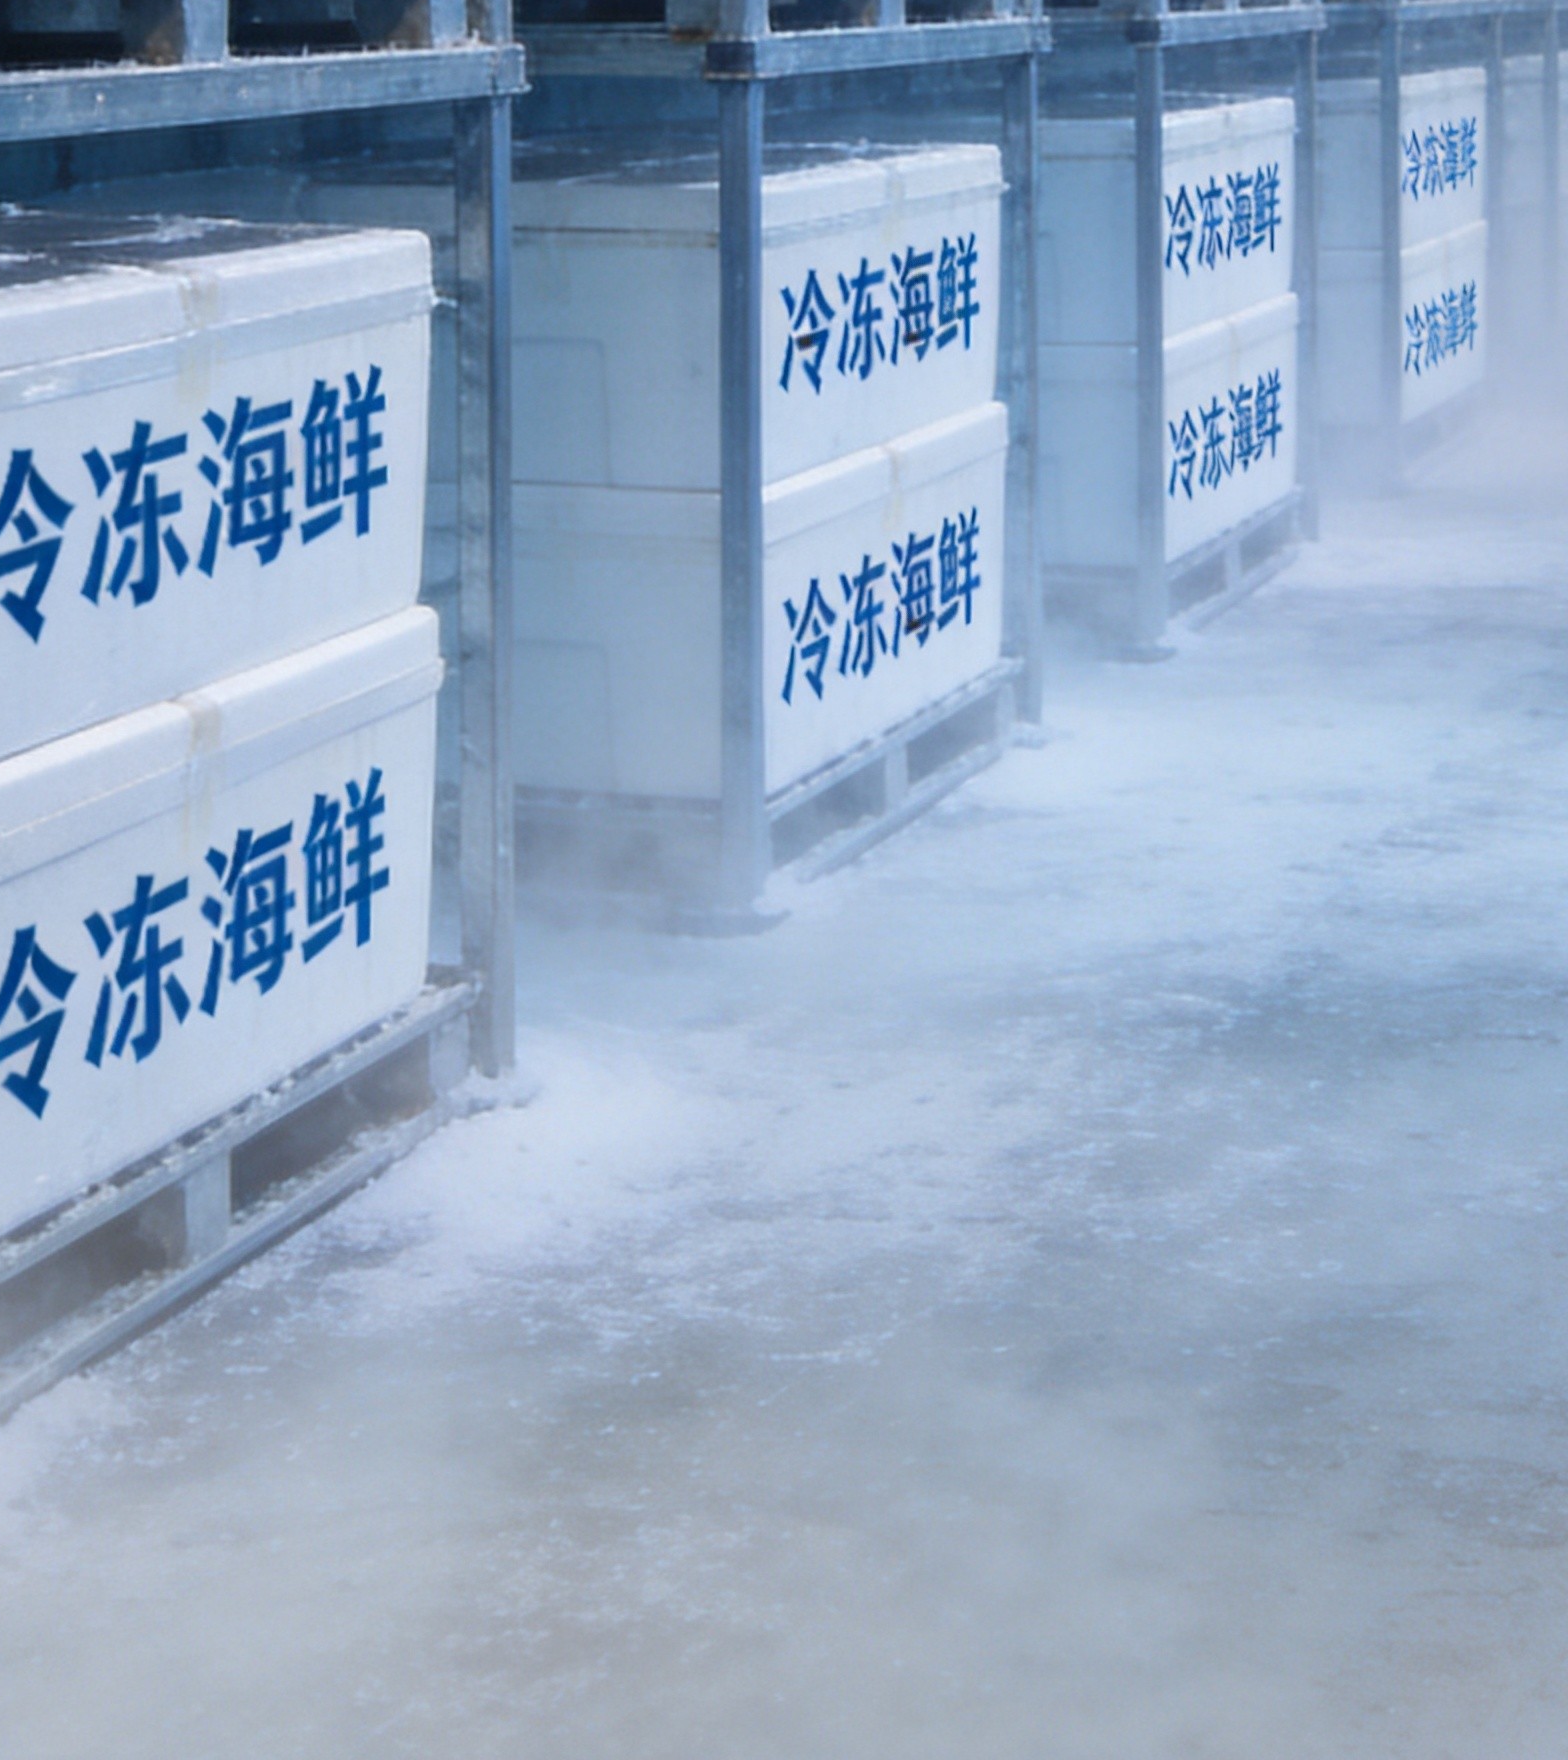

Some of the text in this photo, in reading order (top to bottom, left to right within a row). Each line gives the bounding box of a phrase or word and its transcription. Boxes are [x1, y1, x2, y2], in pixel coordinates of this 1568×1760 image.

[1165, 163, 1282, 277] 冷冻海鲜
[779, 233, 980, 394] 冷冻海鲜
[781, 506, 981, 705] 冷冻海鲜
